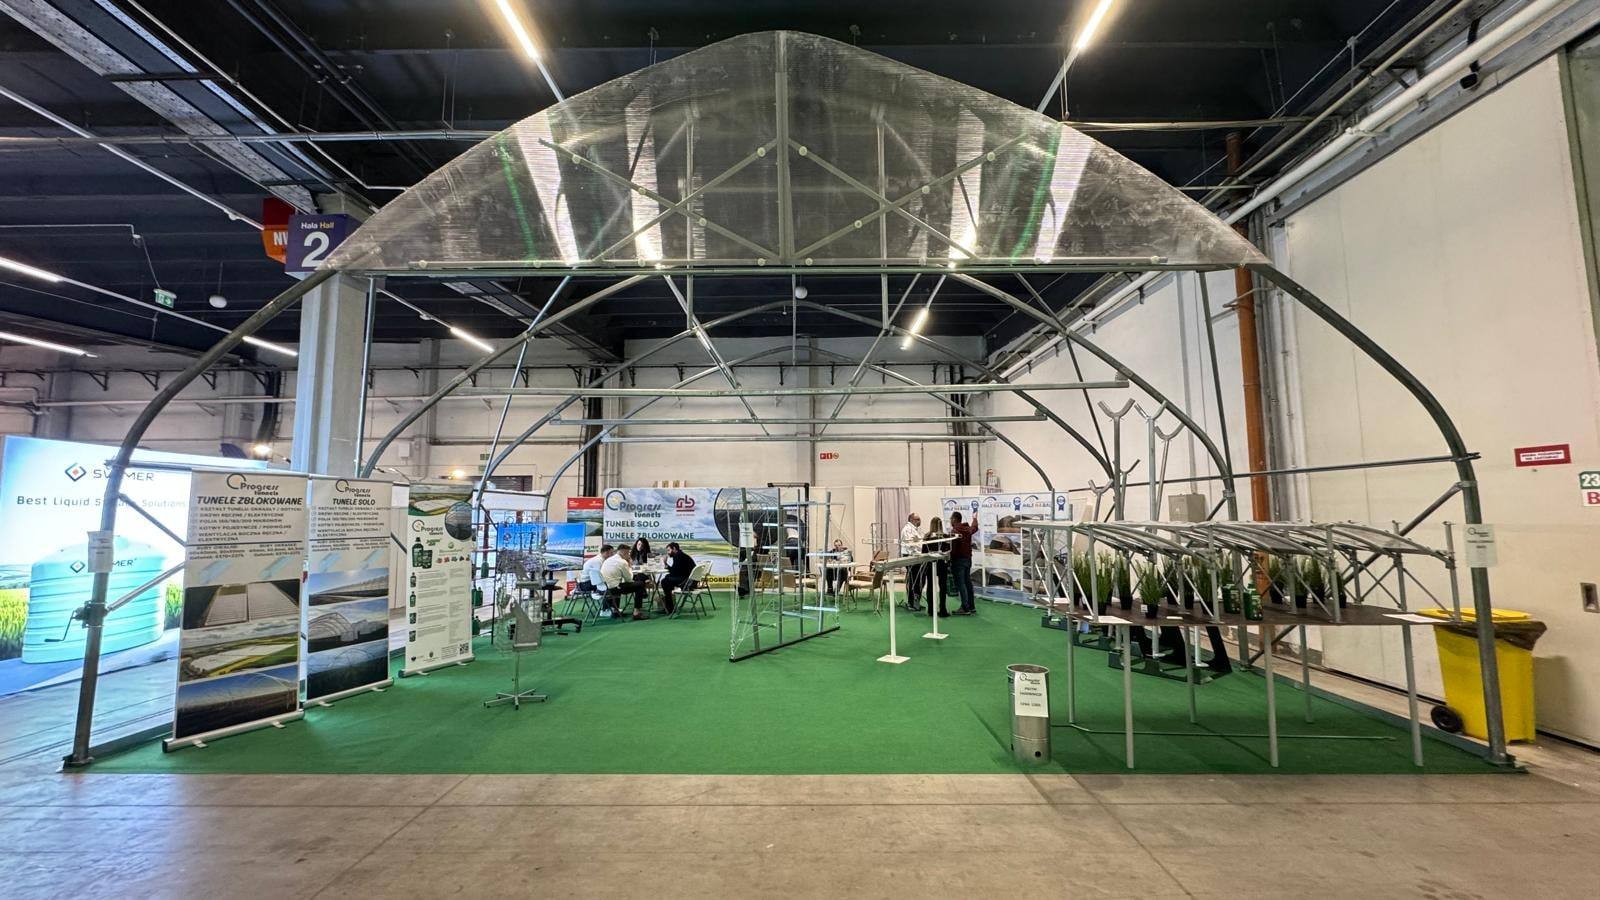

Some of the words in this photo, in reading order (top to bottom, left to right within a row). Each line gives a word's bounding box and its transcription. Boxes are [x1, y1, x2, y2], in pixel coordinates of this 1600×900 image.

[319, 221, 335, 229] Hall
[301, 231, 330, 268] 2
[93, 469, 154, 481] SWMER
[16, 495, 47, 505] Best
[53, 496, 90, 507] Liquid
[197, 496, 236, 505] TUNELE
[237, 496, 303, 506] ZBLOKOWANE
[358, 498, 376, 506] SOLO
[620, 502, 662, 512] Progress
[605, 520, 635, 528] TUNELE
[637, 520, 660, 528] SOLO
[637, 532, 694, 540] ZBLOKOWANE
